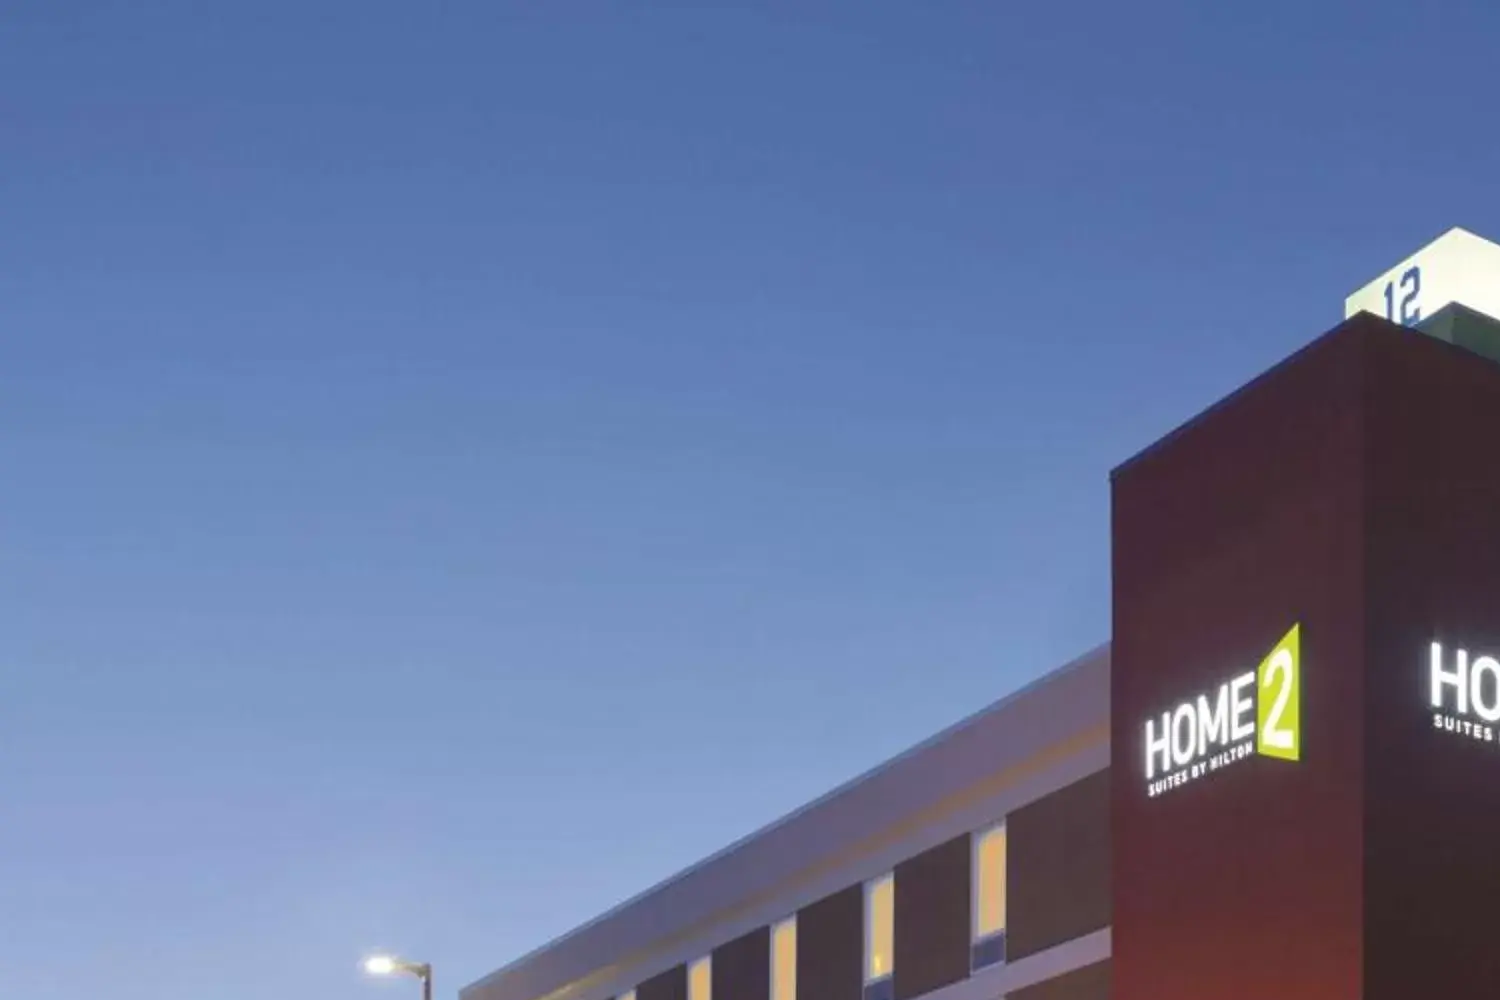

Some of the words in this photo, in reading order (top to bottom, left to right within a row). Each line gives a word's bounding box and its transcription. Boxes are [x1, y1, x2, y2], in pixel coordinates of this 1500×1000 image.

[1384, 266, 1421, 327] 12
[1145, 671, 1255, 779] HOME
[1262, 648, 1294, 749] 2
[1434, 714, 1493, 741] SUITES
[1147, 769, 1188, 797] SUITES
[1191, 762, 1207, 779] BY
[1209, 740, 1253, 770] HILTON
